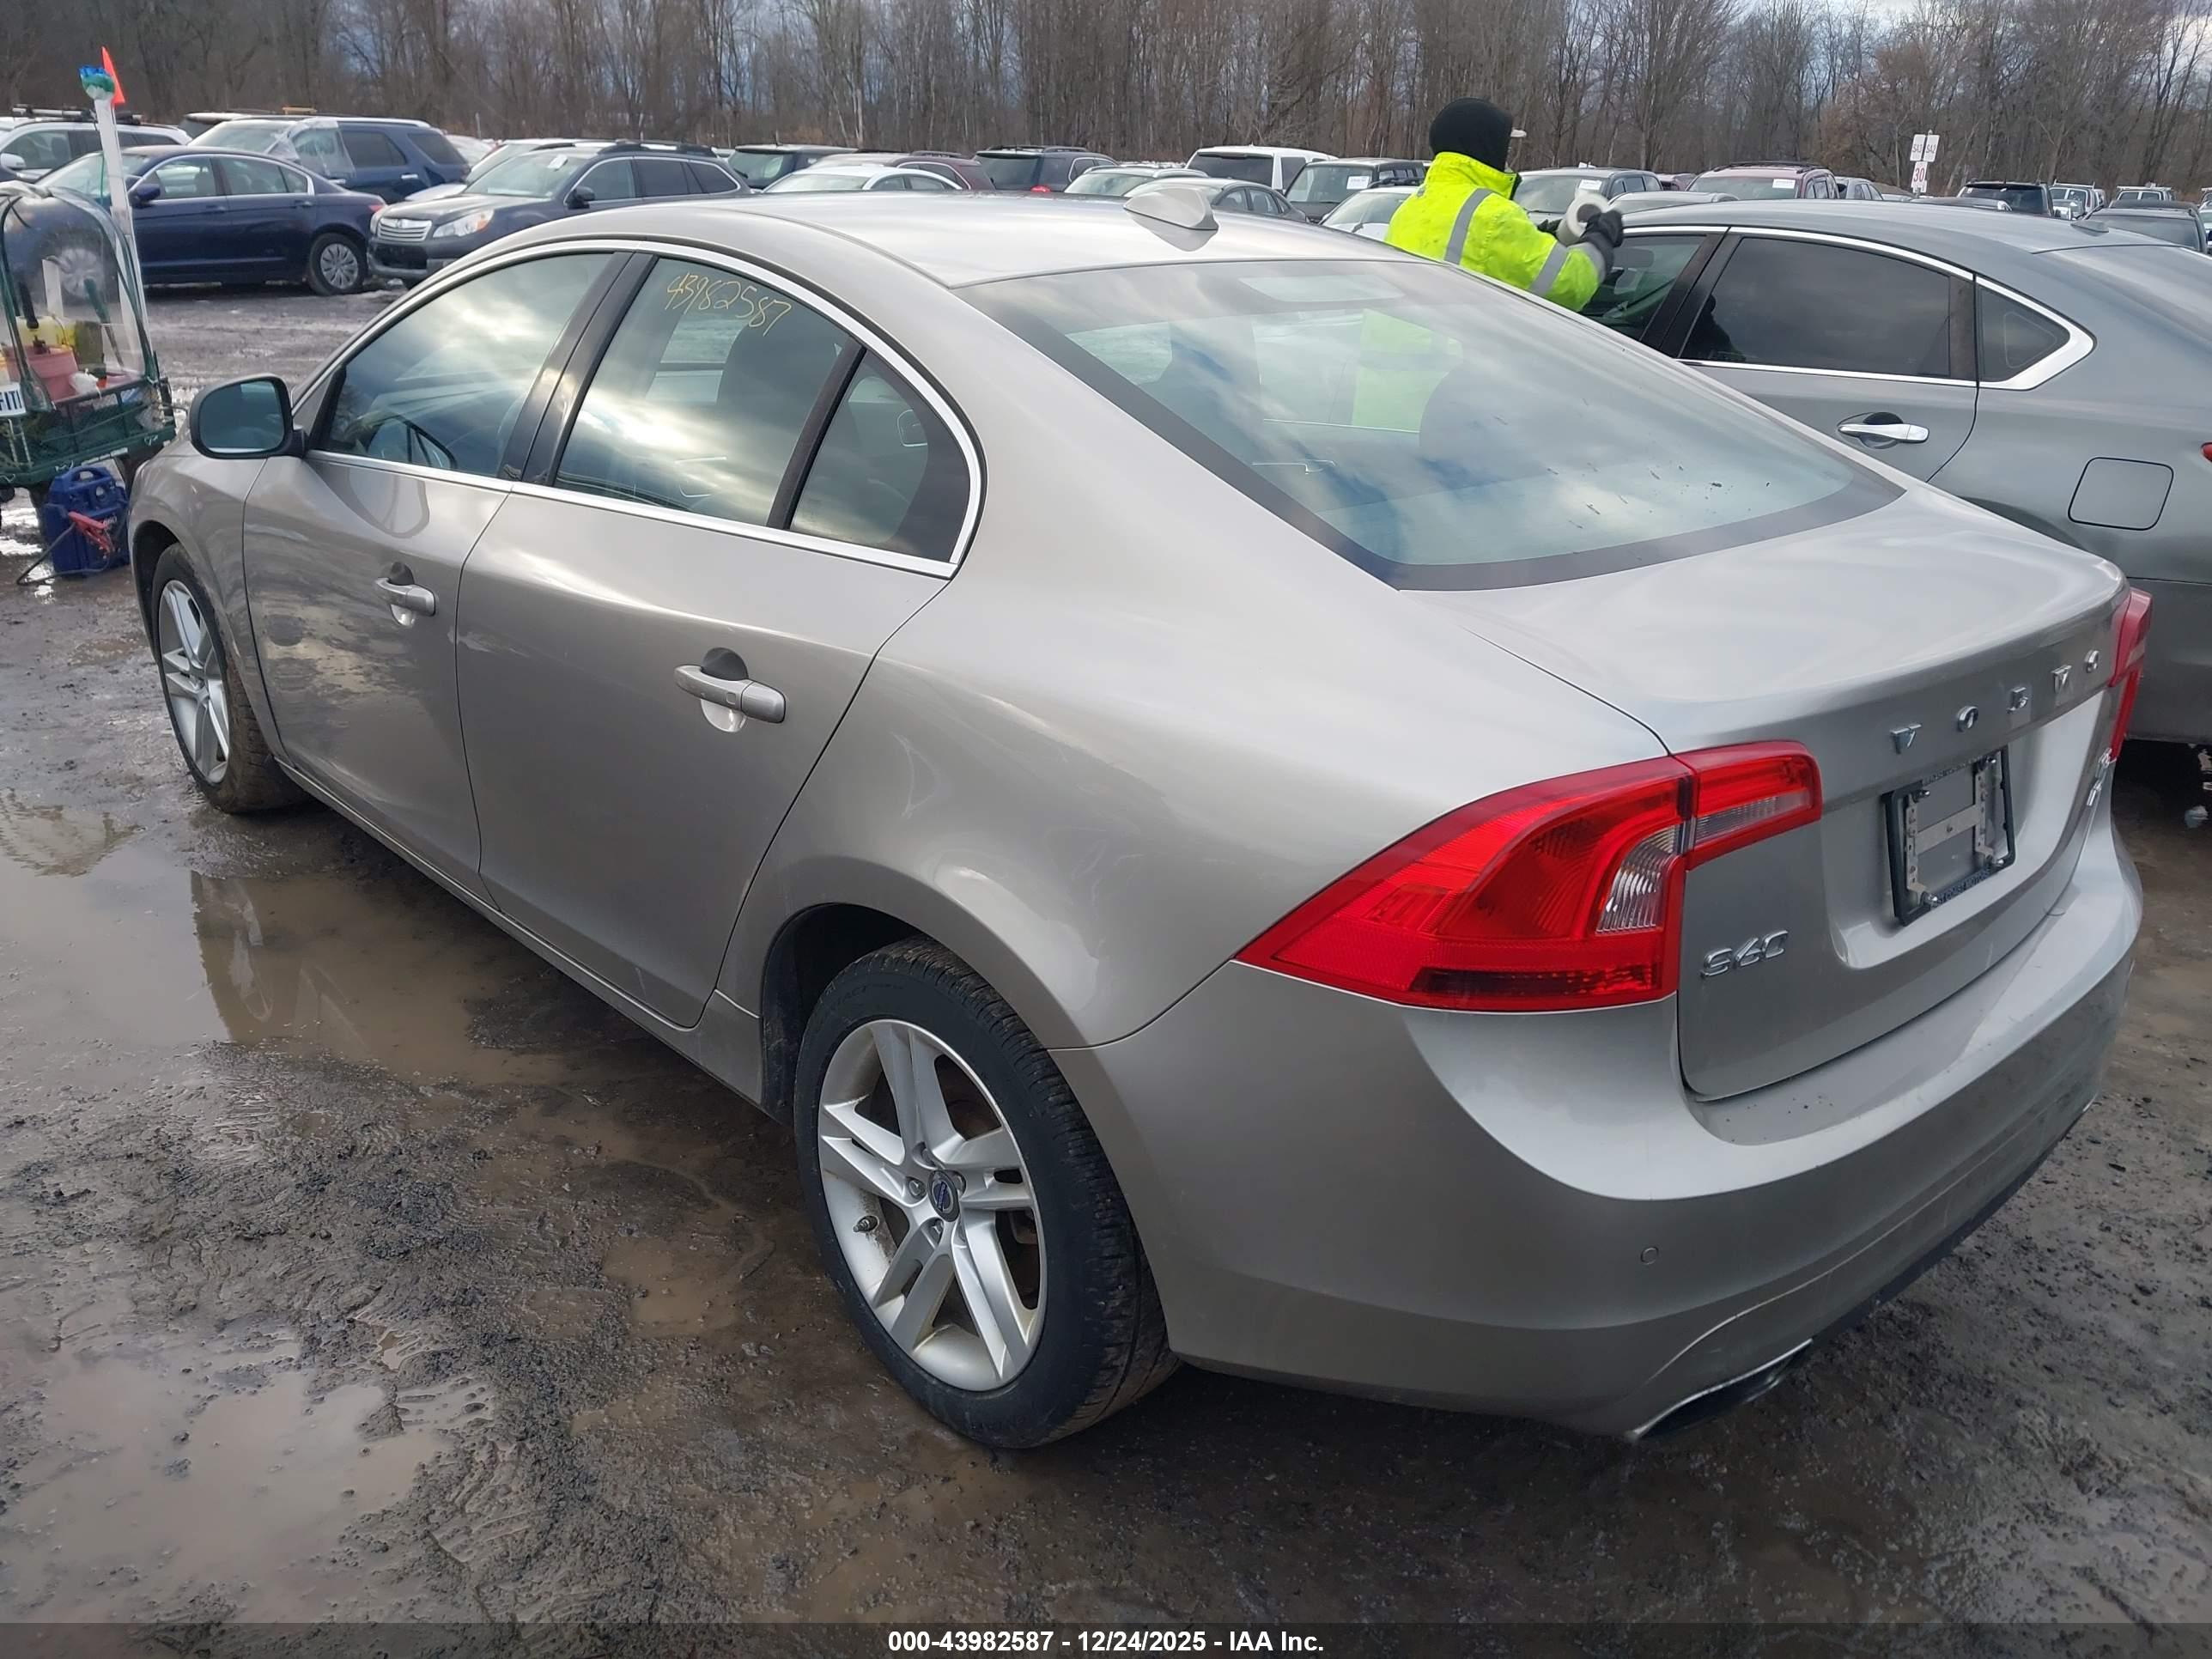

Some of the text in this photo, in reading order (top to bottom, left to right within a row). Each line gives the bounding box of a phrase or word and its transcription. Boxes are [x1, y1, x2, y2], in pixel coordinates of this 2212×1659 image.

[1913, 167, 1924, 182] 30
[665, 272, 792, 336] 43982587
[1889, 649, 2100, 755] VOLVO
[1701, 930, 1789, 977] S60
